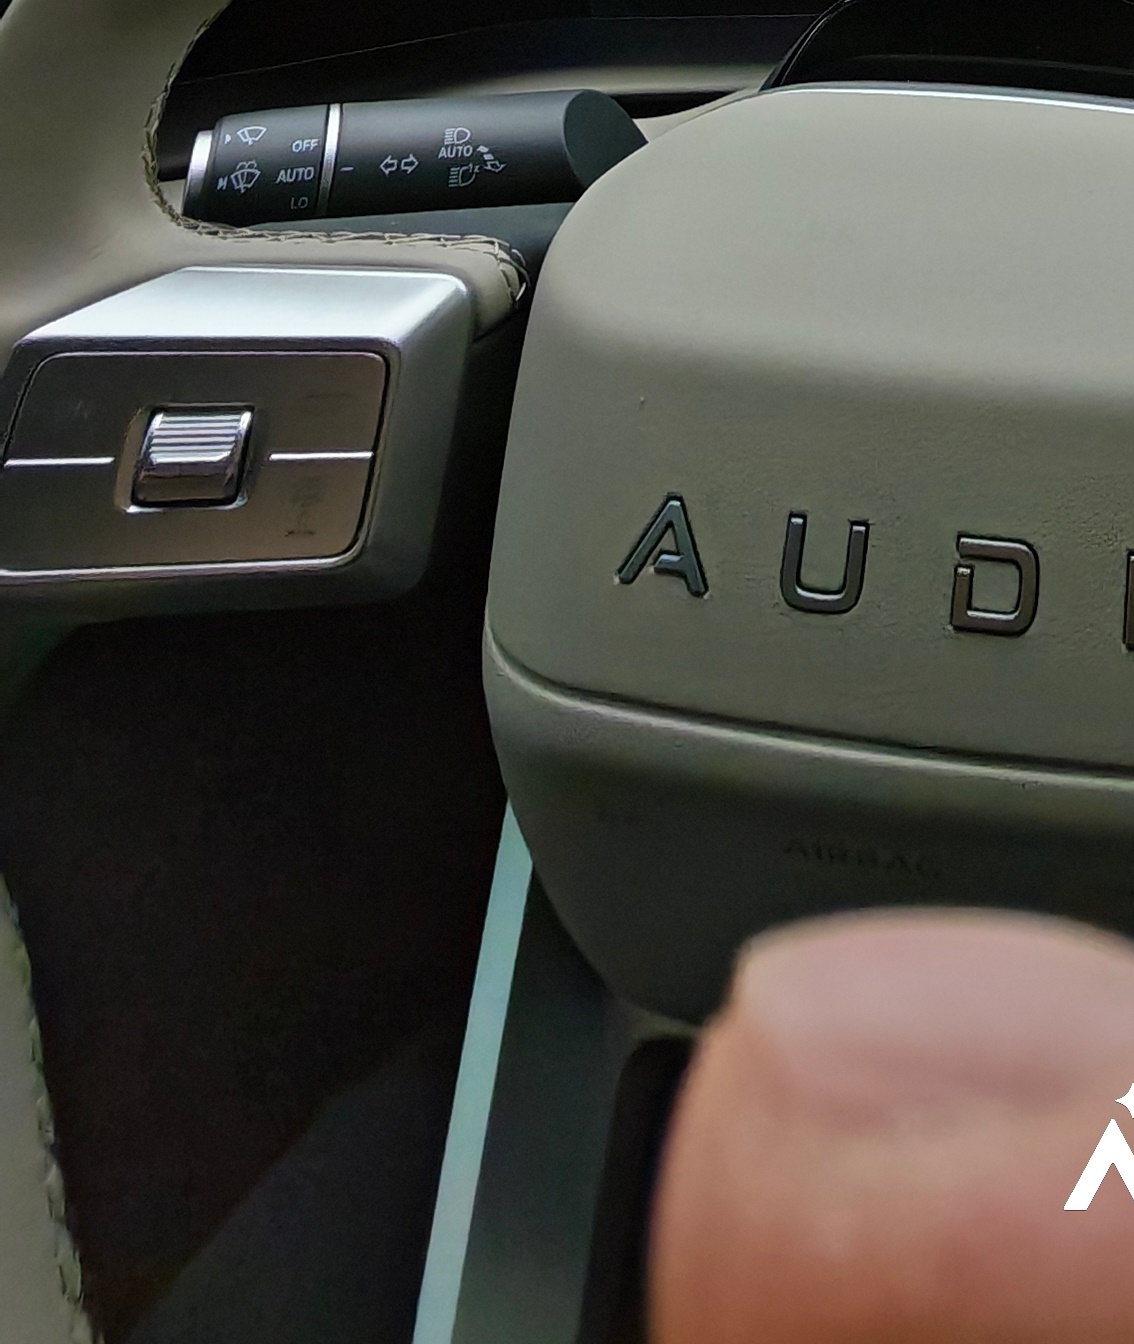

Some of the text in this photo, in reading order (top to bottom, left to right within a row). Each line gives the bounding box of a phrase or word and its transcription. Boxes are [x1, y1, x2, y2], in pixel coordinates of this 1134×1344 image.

[292, 138, 319, 153] OFF
[437, 145, 474, 160] AUTO
[276, 166, 316, 184] AUTO
